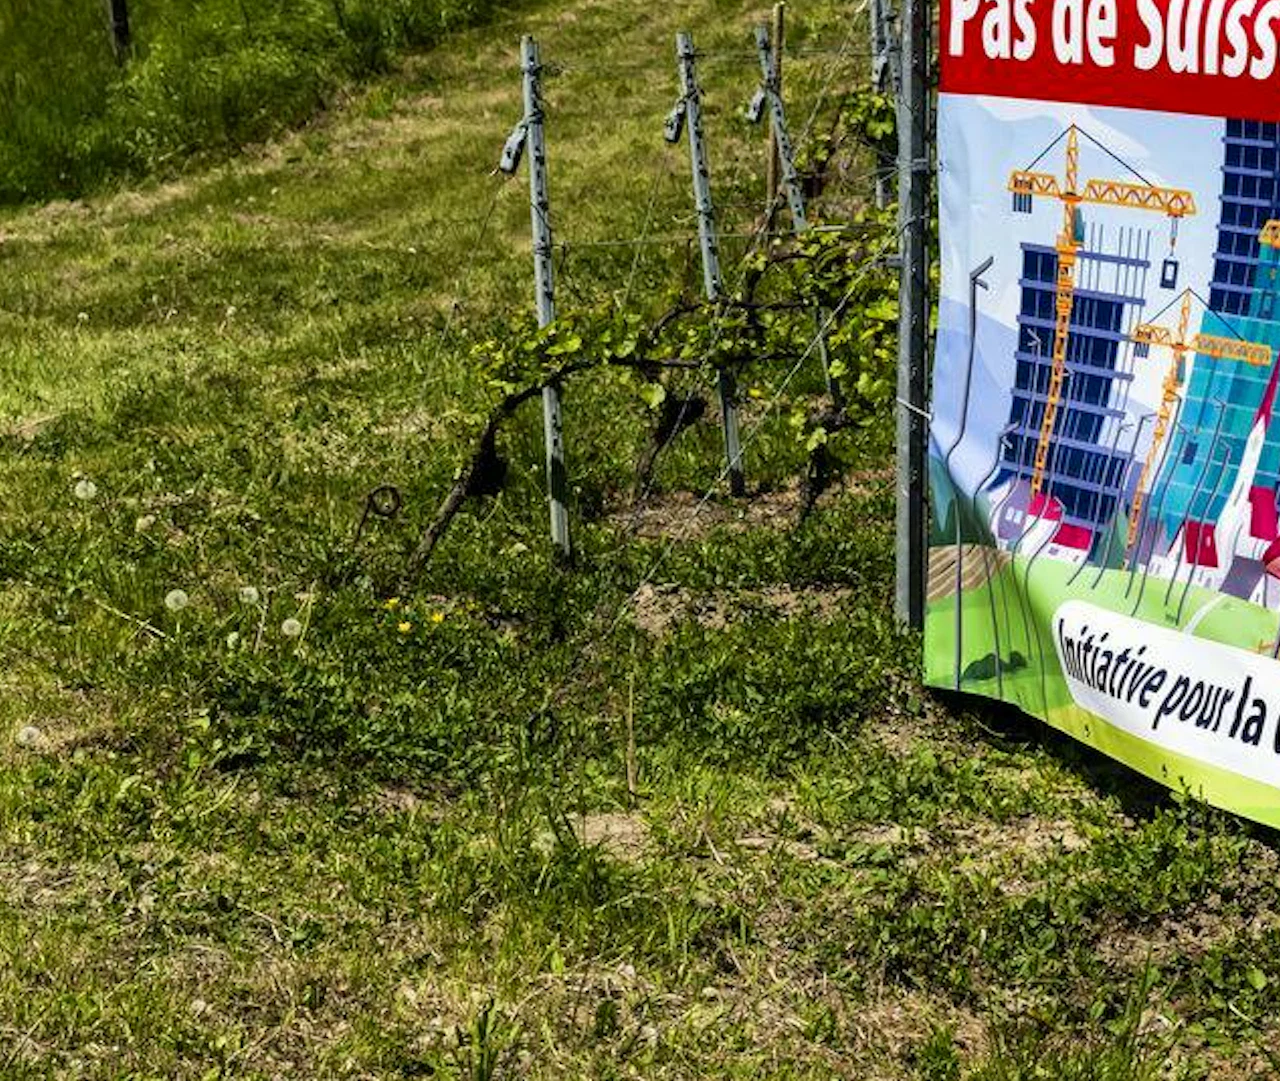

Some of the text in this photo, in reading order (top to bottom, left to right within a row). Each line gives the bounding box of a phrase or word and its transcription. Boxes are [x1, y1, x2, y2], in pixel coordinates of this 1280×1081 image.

[1058, 618, 1168, 708] Initiative
[1151, 675, 1235, 732] pour
[1228, 677, 1267, 746] la
